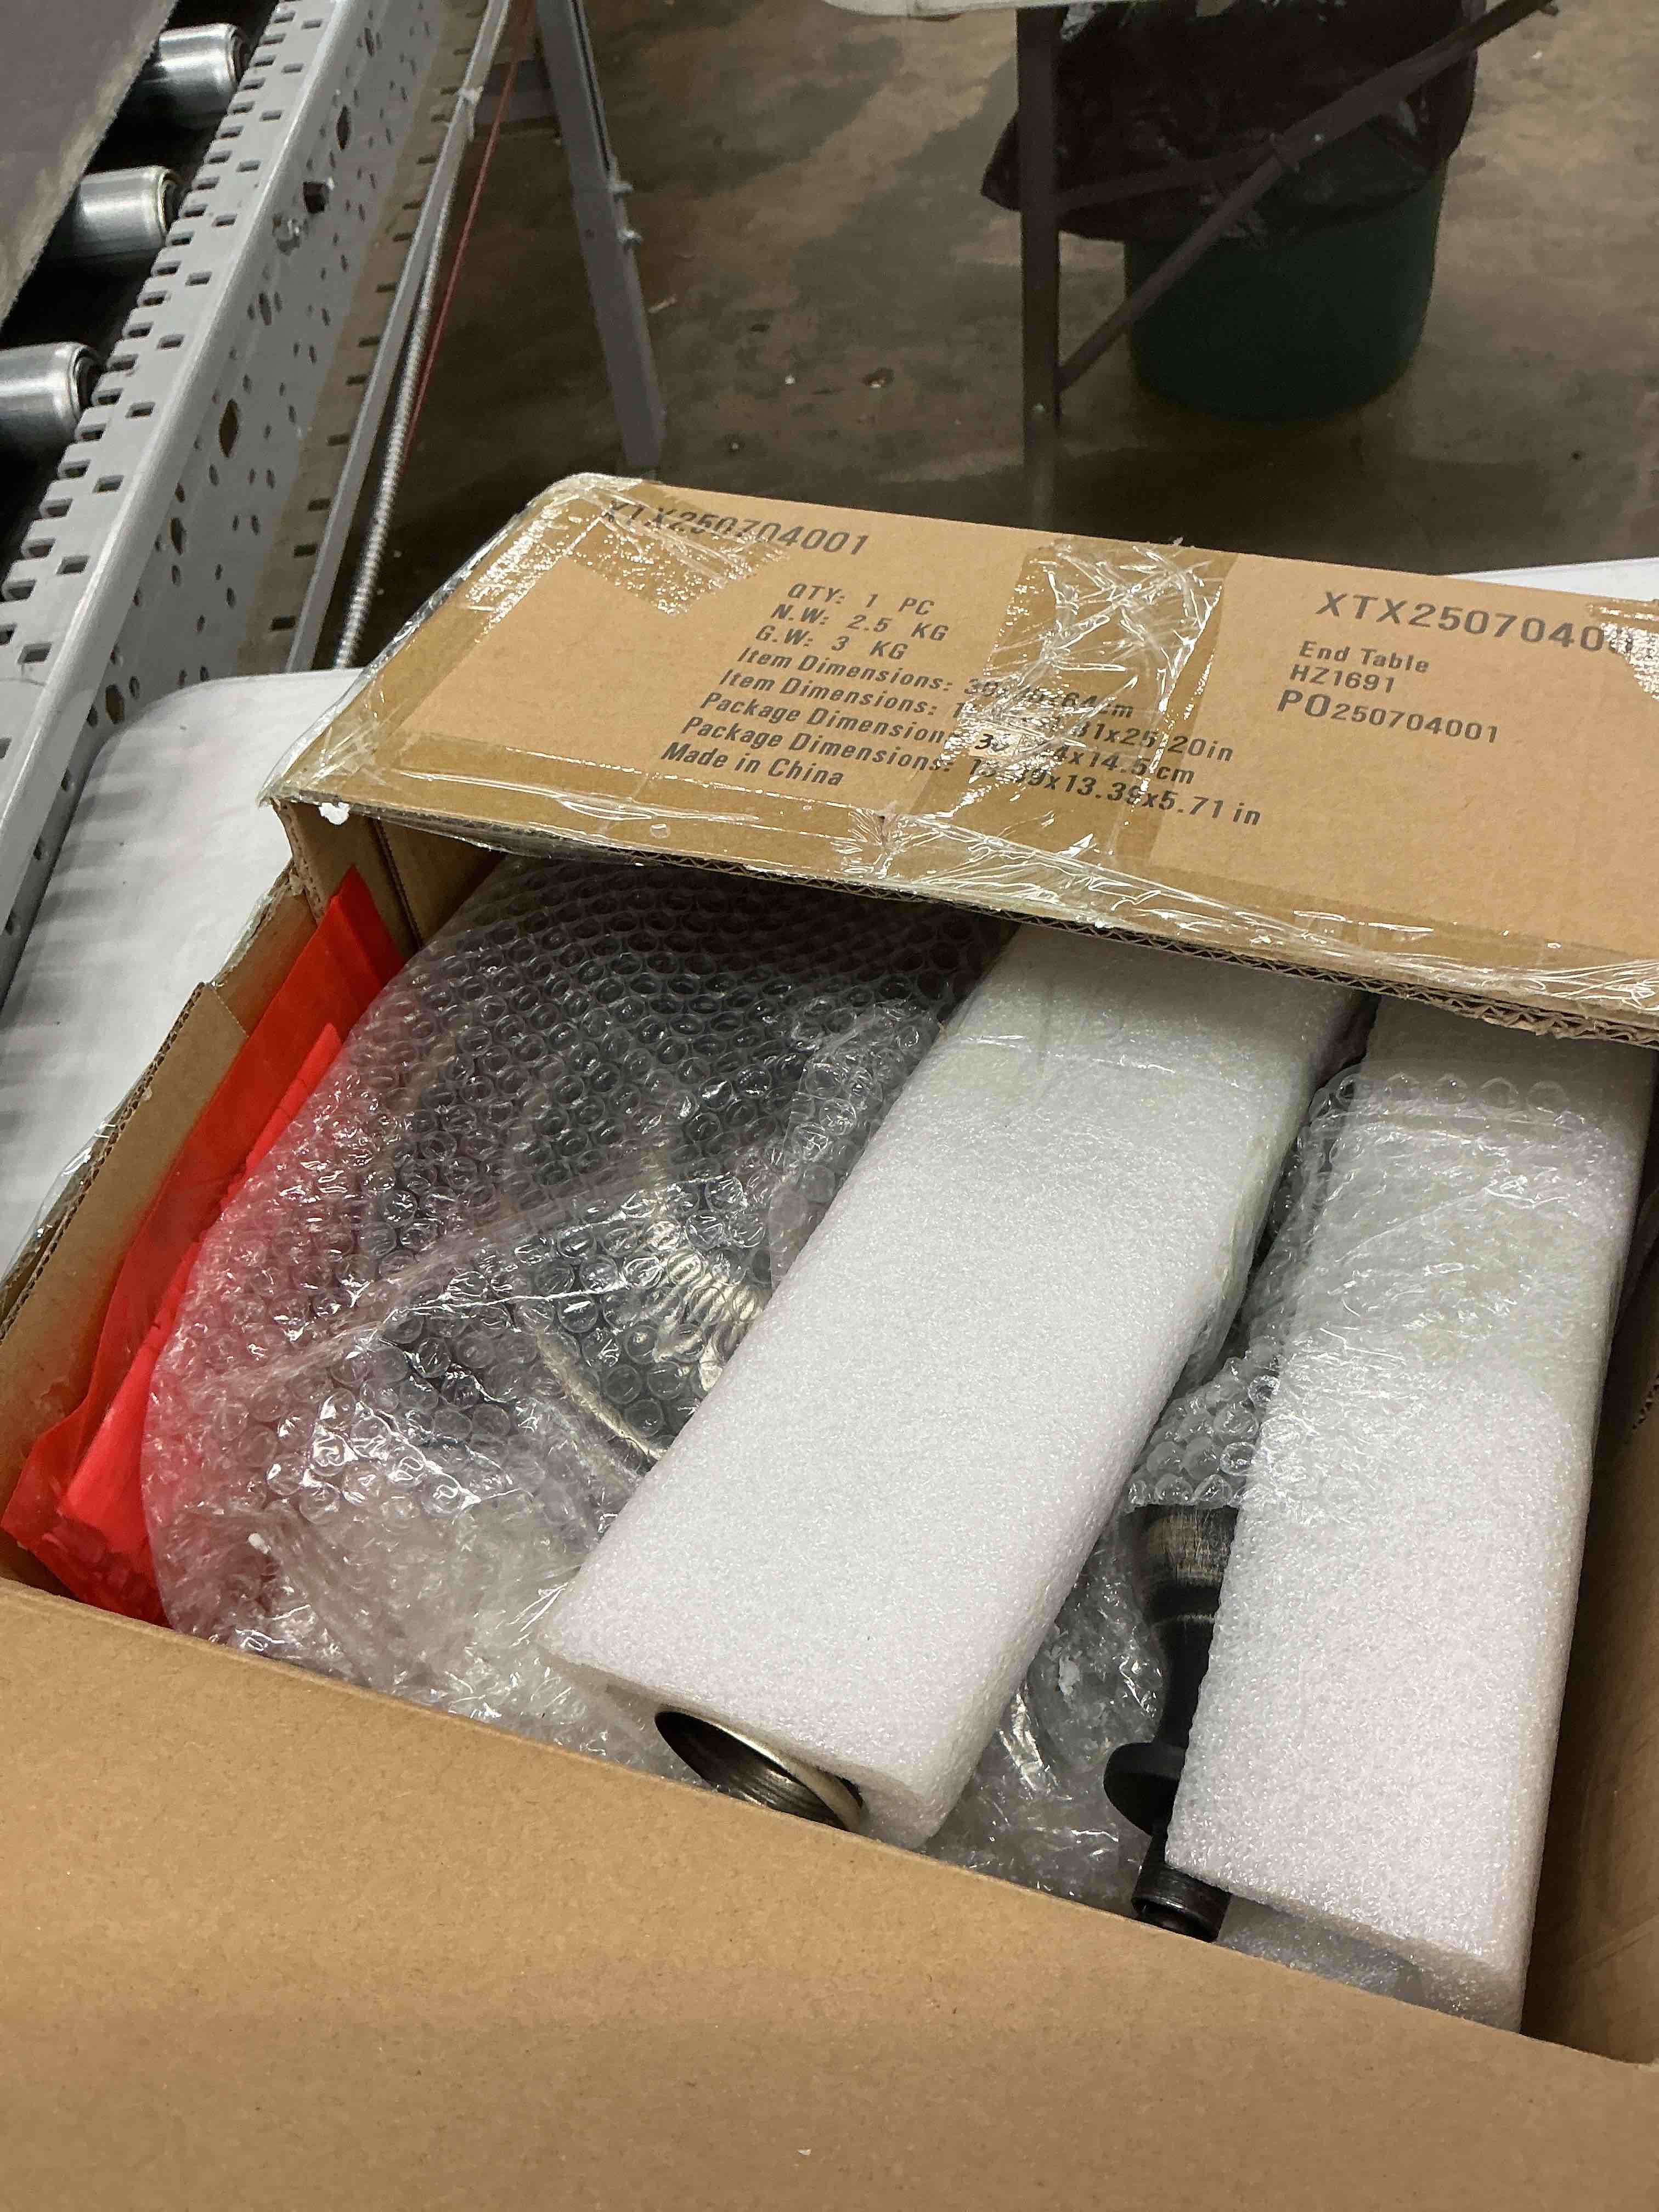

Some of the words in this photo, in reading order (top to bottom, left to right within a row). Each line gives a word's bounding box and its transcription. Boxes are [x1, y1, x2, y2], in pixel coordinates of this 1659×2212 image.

[787, 583, 845, 605] QTY:
[866, 594, 877, 607] 1
[899, 598, 935, 616] PC
[771, 604, 829, 626] N.W:
[848, 615, 892, 633] 2.5
[912, 623, 949, 641] KG
[755, 625, 814, 647] G.W:
[832, 636, 850, 651] 3
[870, 641, 909, 660] KG
[1299, 640, 1352, 662] End
[1360, 648, 1430, 673] Table
[737, 647, 792, 670] Item
[798, 655, 953, 691] Dimensions:
[1289, 663, 1395, 694] HZ1691
[700, 692, 800, 723] Package
[719, 669, 774, 691] Item
[780, 678, 938, 715] Dimensions:
[681, 716, 783, 750] Package
[1277, 689, 1498, 743] PO250704001
[661, 742, 729, 769] Made
[735, 753, 762, 774] in
[768, 759, 844, 787] China
